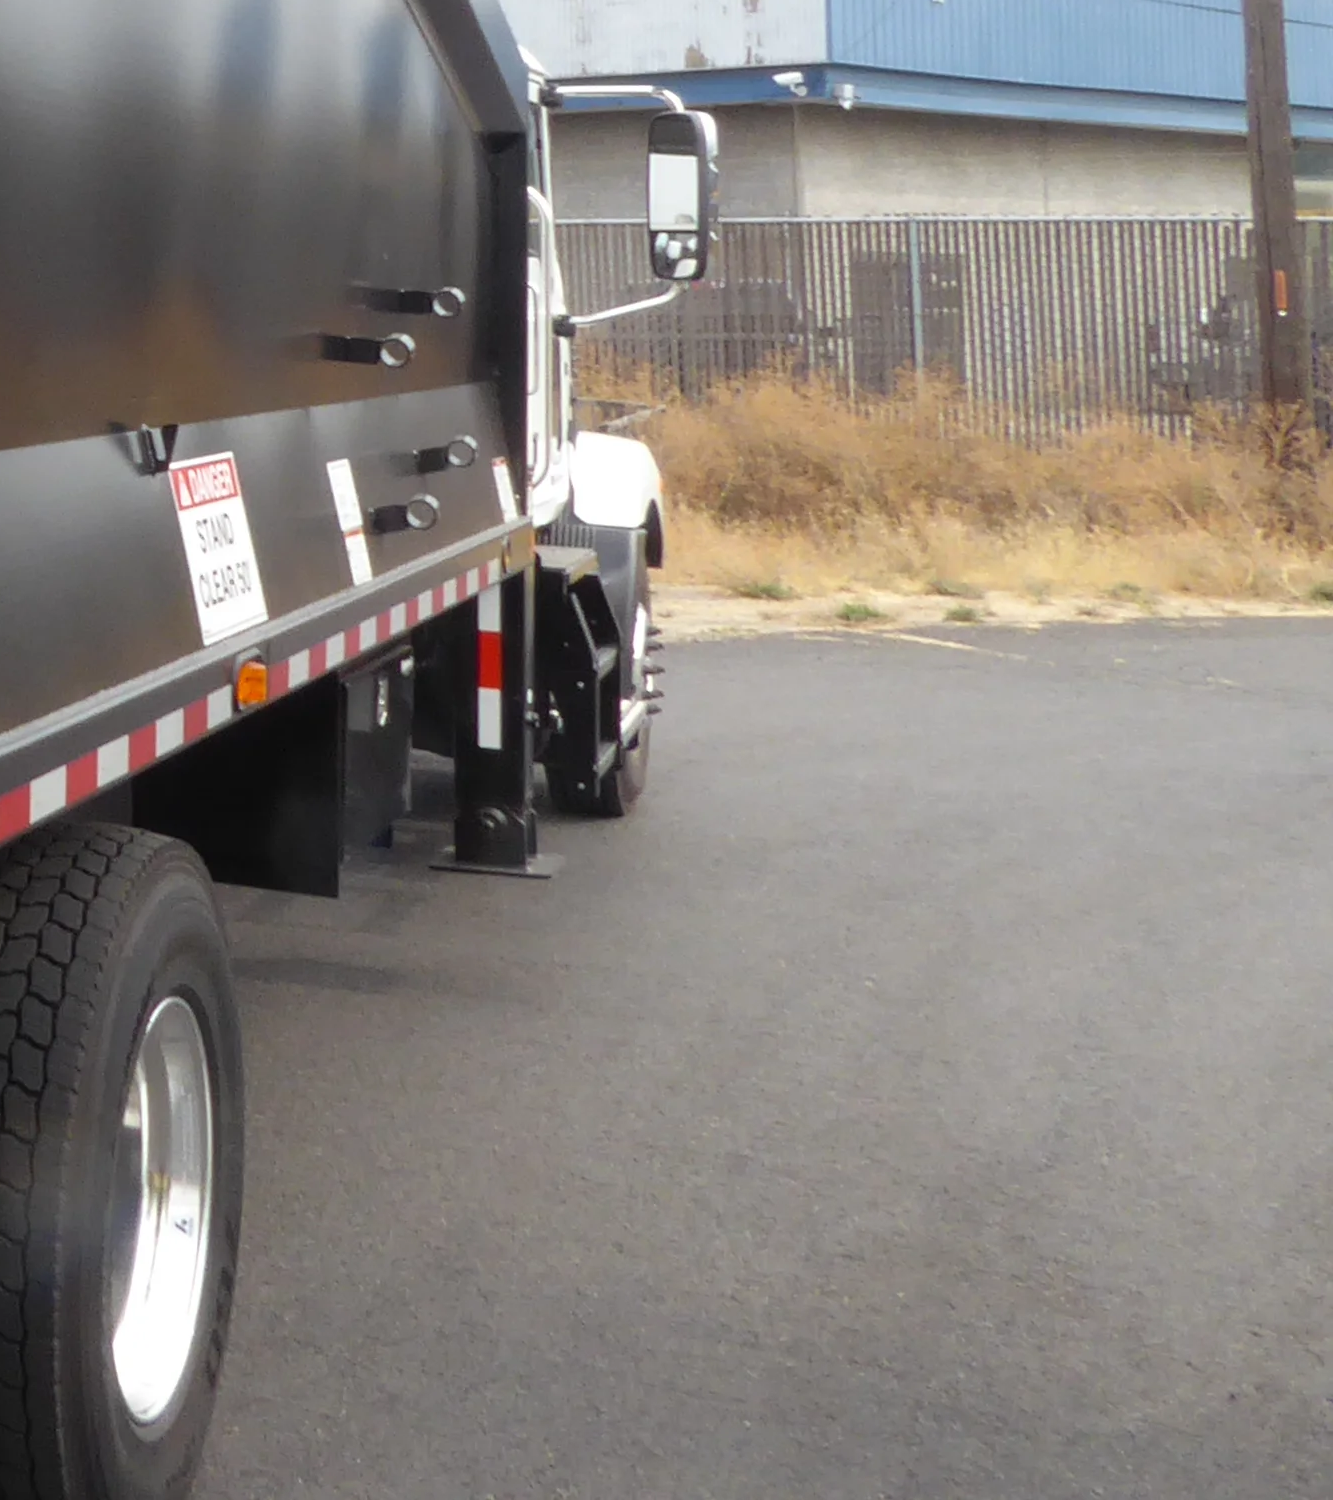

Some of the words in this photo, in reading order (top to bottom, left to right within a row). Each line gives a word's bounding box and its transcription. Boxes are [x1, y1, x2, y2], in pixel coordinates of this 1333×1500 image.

[188, 462, 235, 504] DANGER
[195, 513, 235, 554] STAND
[198, 566, 239, 608] CLEAR
